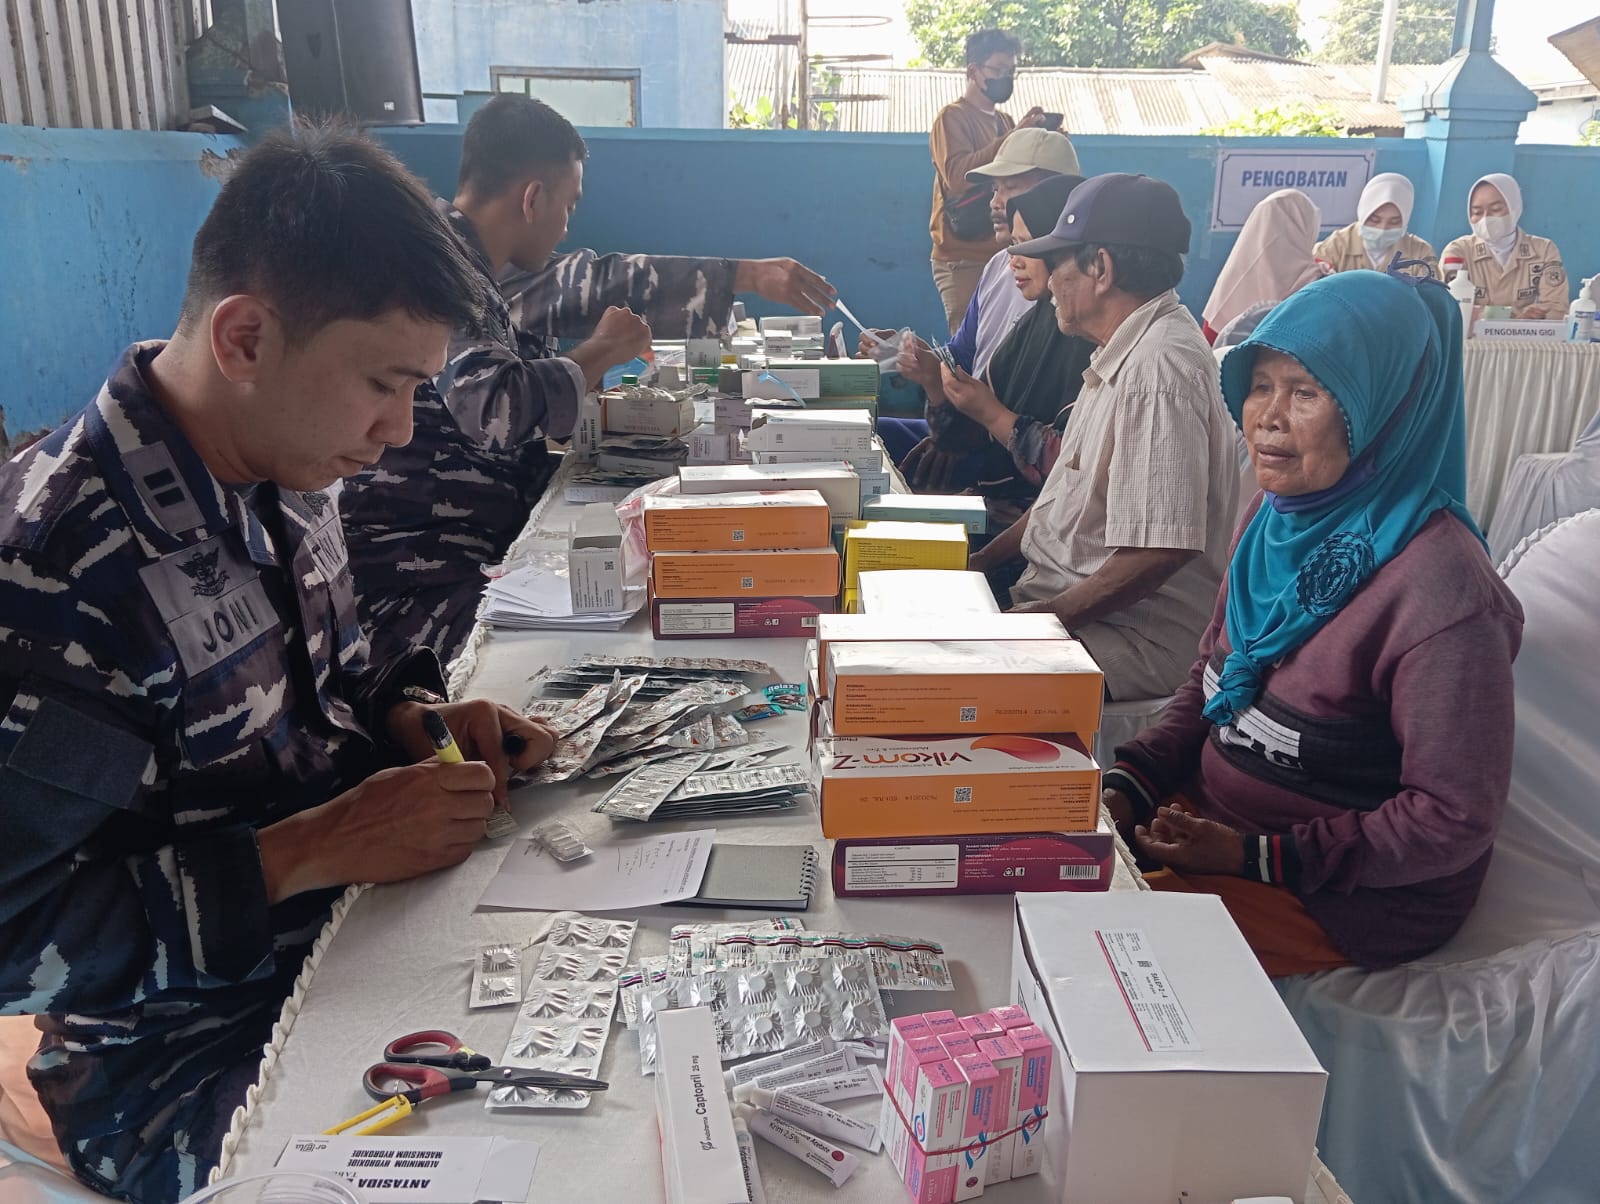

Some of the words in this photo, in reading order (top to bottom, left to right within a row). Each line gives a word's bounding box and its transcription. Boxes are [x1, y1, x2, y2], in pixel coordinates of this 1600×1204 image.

[1241, 169, 1348, 188] PENGOBATAN
[1484, 328, 1537, 337] PENGOBATAN
[1538, 328, 1556, 337] GIGI
[202, 595, 260, 653] JONI
[690, 1054, 700, 1065] mg
[691, 1064, 700, 1072] 25
[690, 1074, 708, 1115] Captopril
[768, 1121, 785, 1135] Krim
[810, 1137, 831, 1154] Acetate
[396, 1150, 443, 1158] MAGNESIUM
[347, 1159, 391, 1167] HYDROXIDE
[394, 1160, 439, 1168] ALUMINIUM
[358, 1179, 431, 1189] ANTASIDA
